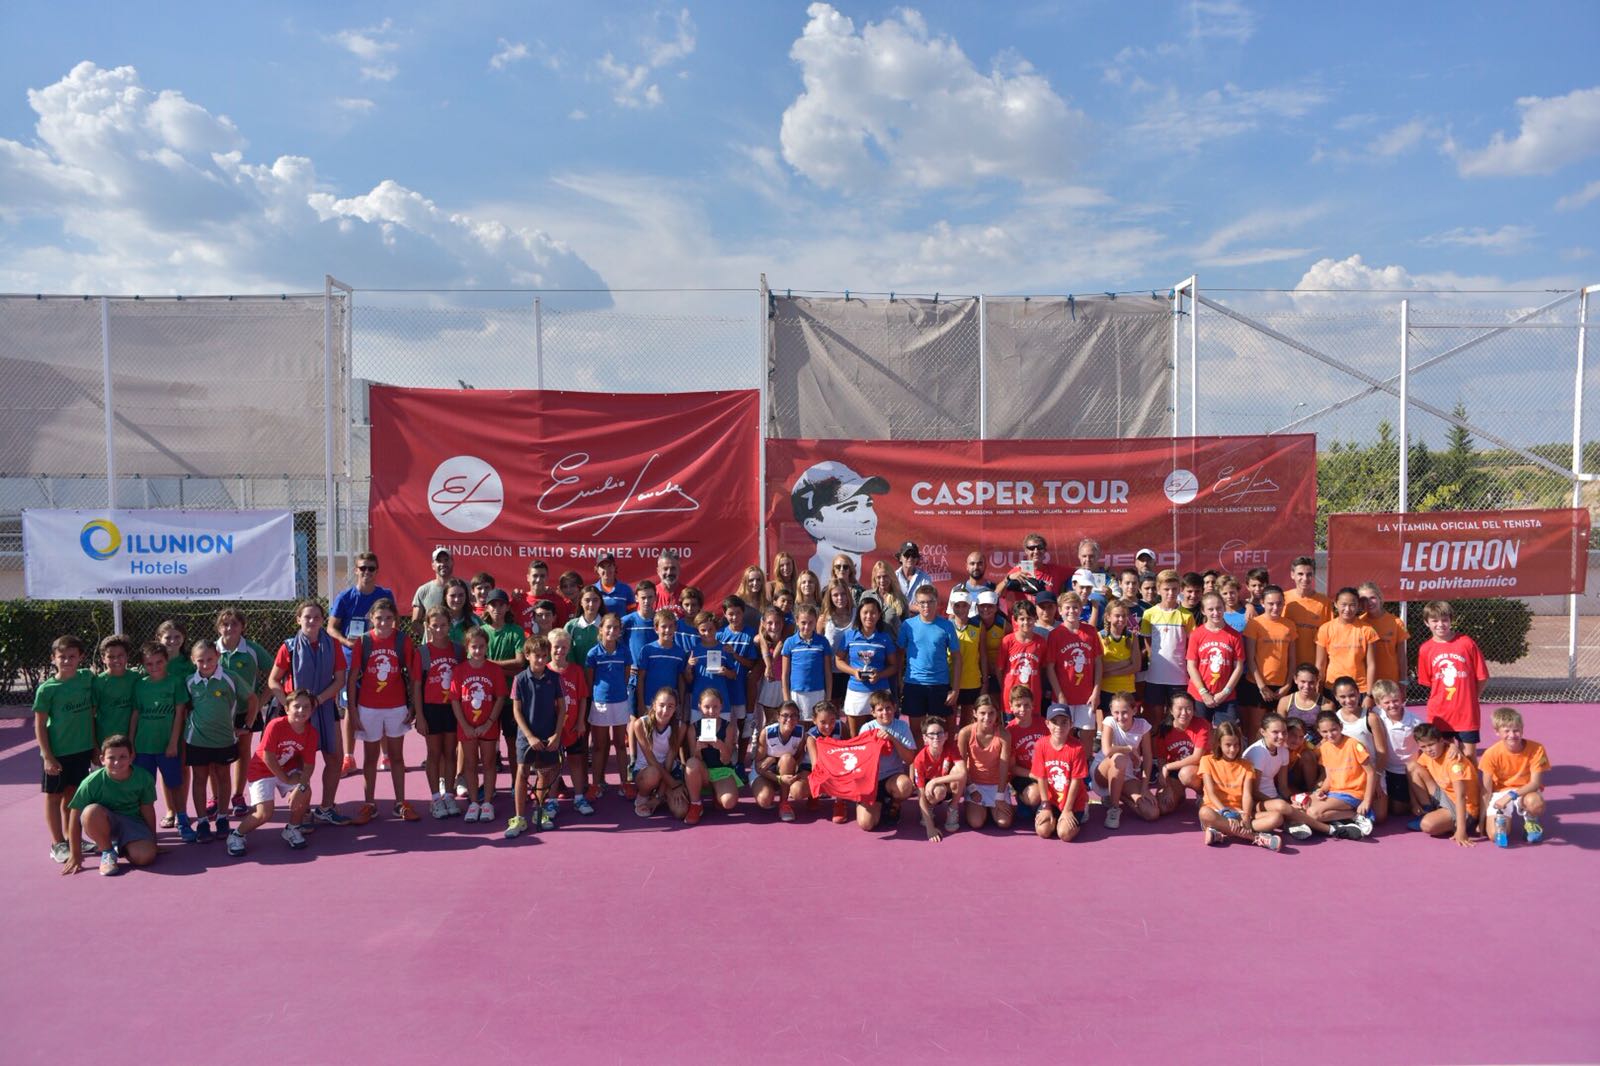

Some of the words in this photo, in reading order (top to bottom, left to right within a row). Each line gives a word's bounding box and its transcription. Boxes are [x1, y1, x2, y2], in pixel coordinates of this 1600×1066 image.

[911, 481, 1034, 505] CASPER
[1043, 480, 1129, 505] TOUR
[1377, 523, 1390, 532] LA
[1392, 522, 1438, 532] VITAMINA
[1440, 521, 1480, 530] OFICIAL
[1483, 520, 1500, 529] DEL
[1503, 519, 1542, 528] TENISTA
[127, 534, 233, 554] ILUNION
[919, 544, 948, 556] OCOS
[519, 546, 564, 558] EMILIO
[1233, 550, 1271, 564] RFET
[1400, 539, 1520, 572] LEOTRON
[1097, 552, 1181, 567] HED
[131, 560, 188, 575] Hotels
[96, 586, 220, 595] www.ilunionhotels.com
[1400, 578, 1414, 590] Tu
[1419, 575, 1517, 592] polivitamínico
[1445, 687, 1457, 701] 7
